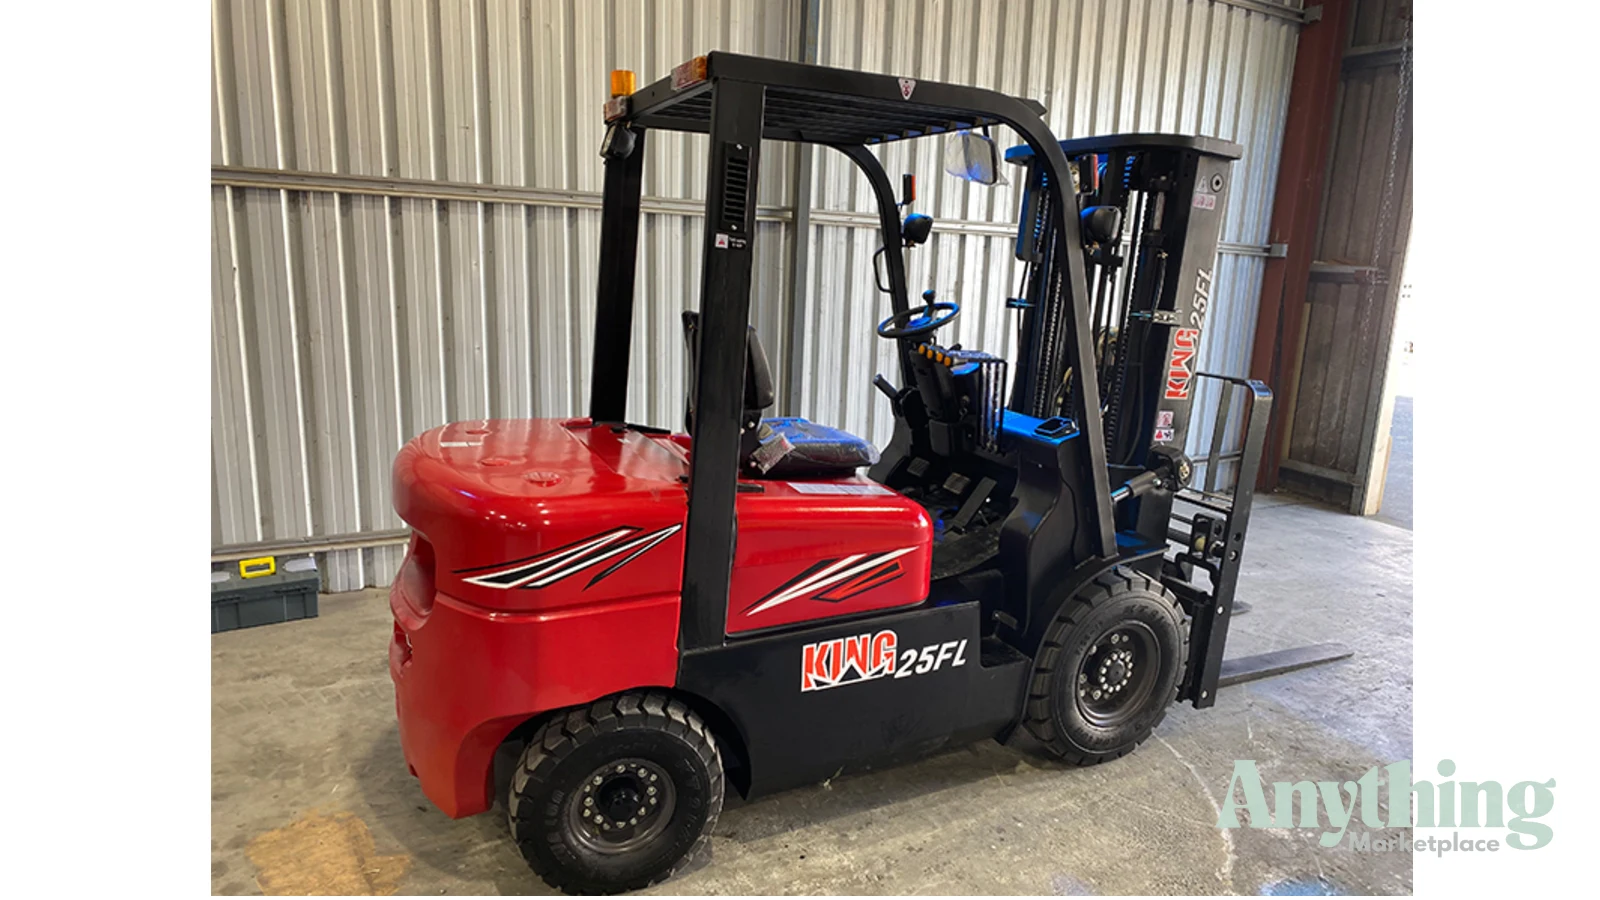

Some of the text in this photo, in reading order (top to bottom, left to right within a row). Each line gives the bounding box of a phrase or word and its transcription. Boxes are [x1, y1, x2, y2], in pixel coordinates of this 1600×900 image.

[1165, 269, 1212, 399] KING 25FL
[801, 630, 968, 691] KING 25FL
